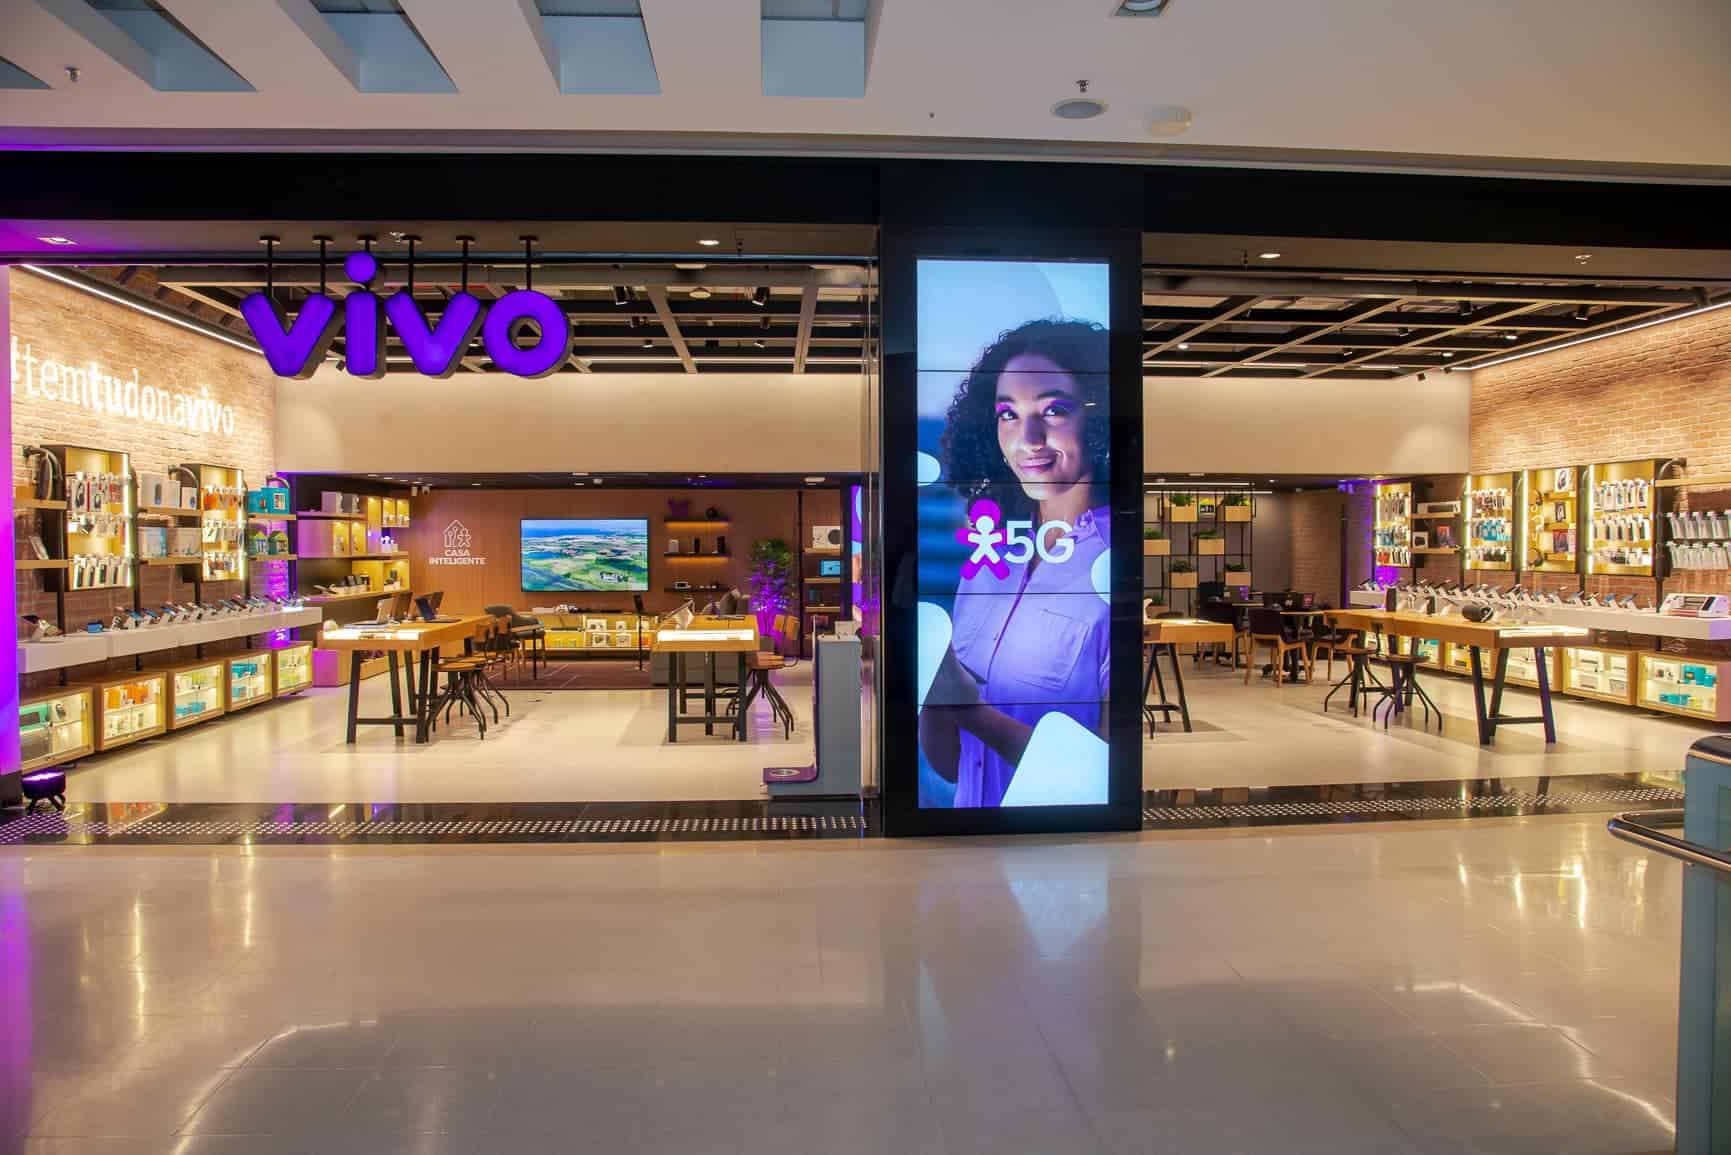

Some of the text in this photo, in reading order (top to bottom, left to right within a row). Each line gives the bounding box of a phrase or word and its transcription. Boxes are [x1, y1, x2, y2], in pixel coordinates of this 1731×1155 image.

[240, 251, 570, 378] vivo
[444, 549, 471, 557] CASA
[1003, 519, 1075, 564] 5G
[428, 557, 487, 565] INTELIGENTE
